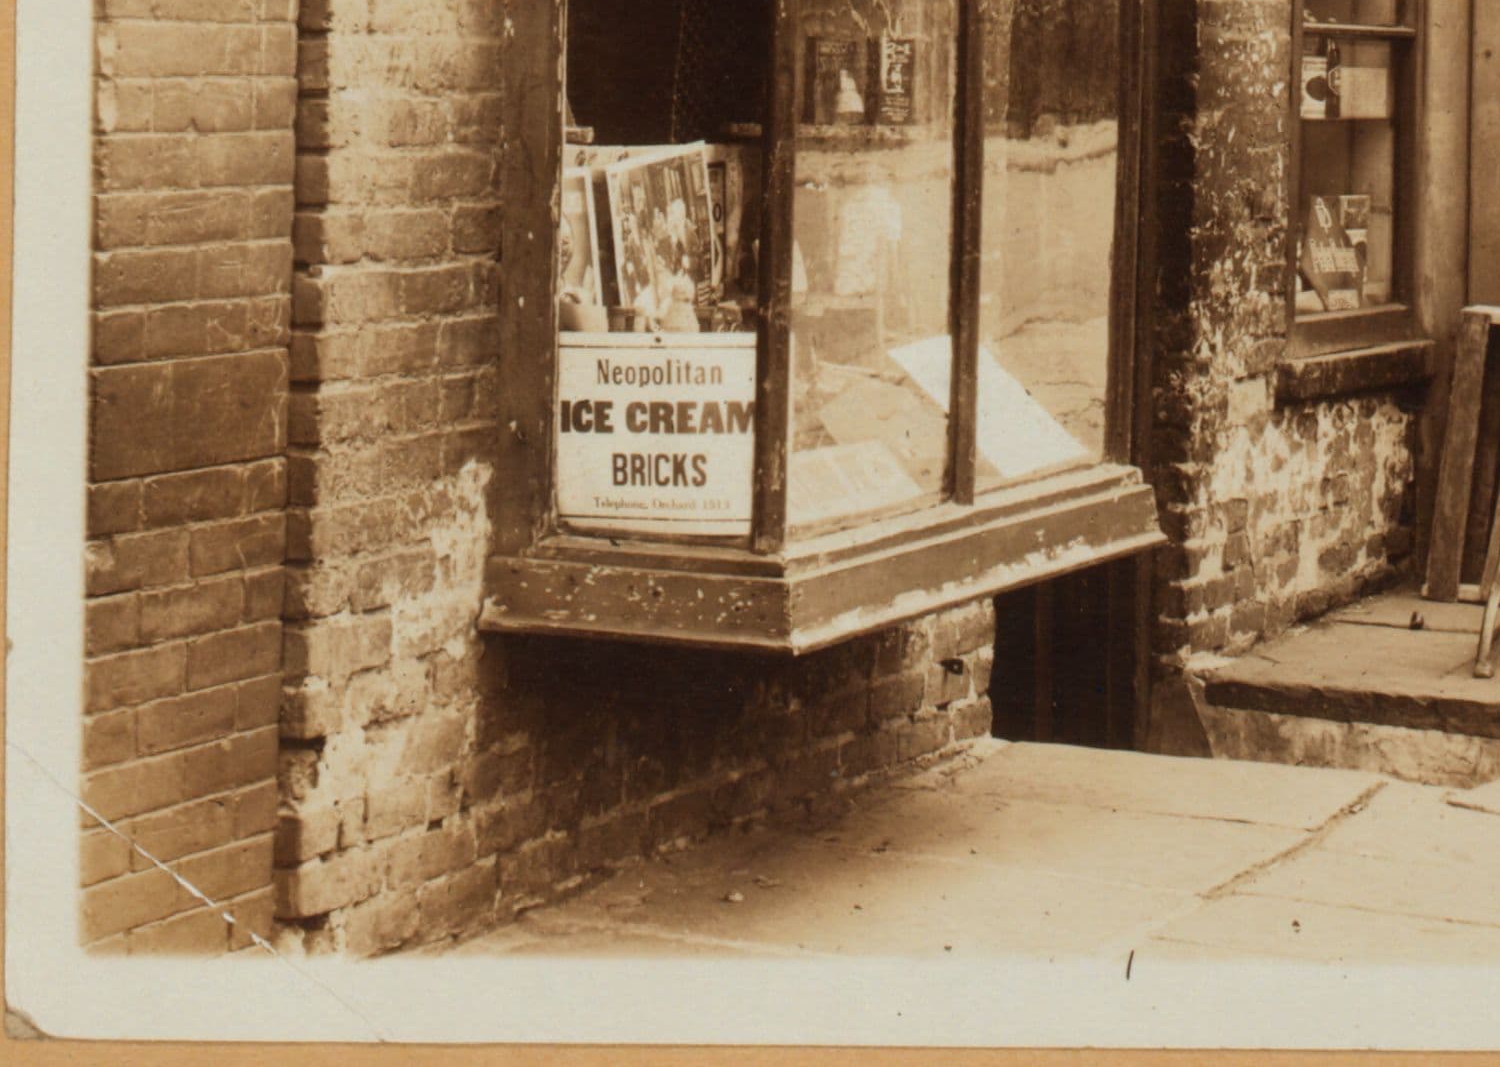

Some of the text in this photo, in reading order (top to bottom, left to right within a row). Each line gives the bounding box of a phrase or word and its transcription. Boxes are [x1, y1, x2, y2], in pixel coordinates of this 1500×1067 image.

[596, 359, 723, 388] Neopolitan
[561, 399, 756, 434] ICE CREAM
[612, 452, 708, 487] BRICKS
